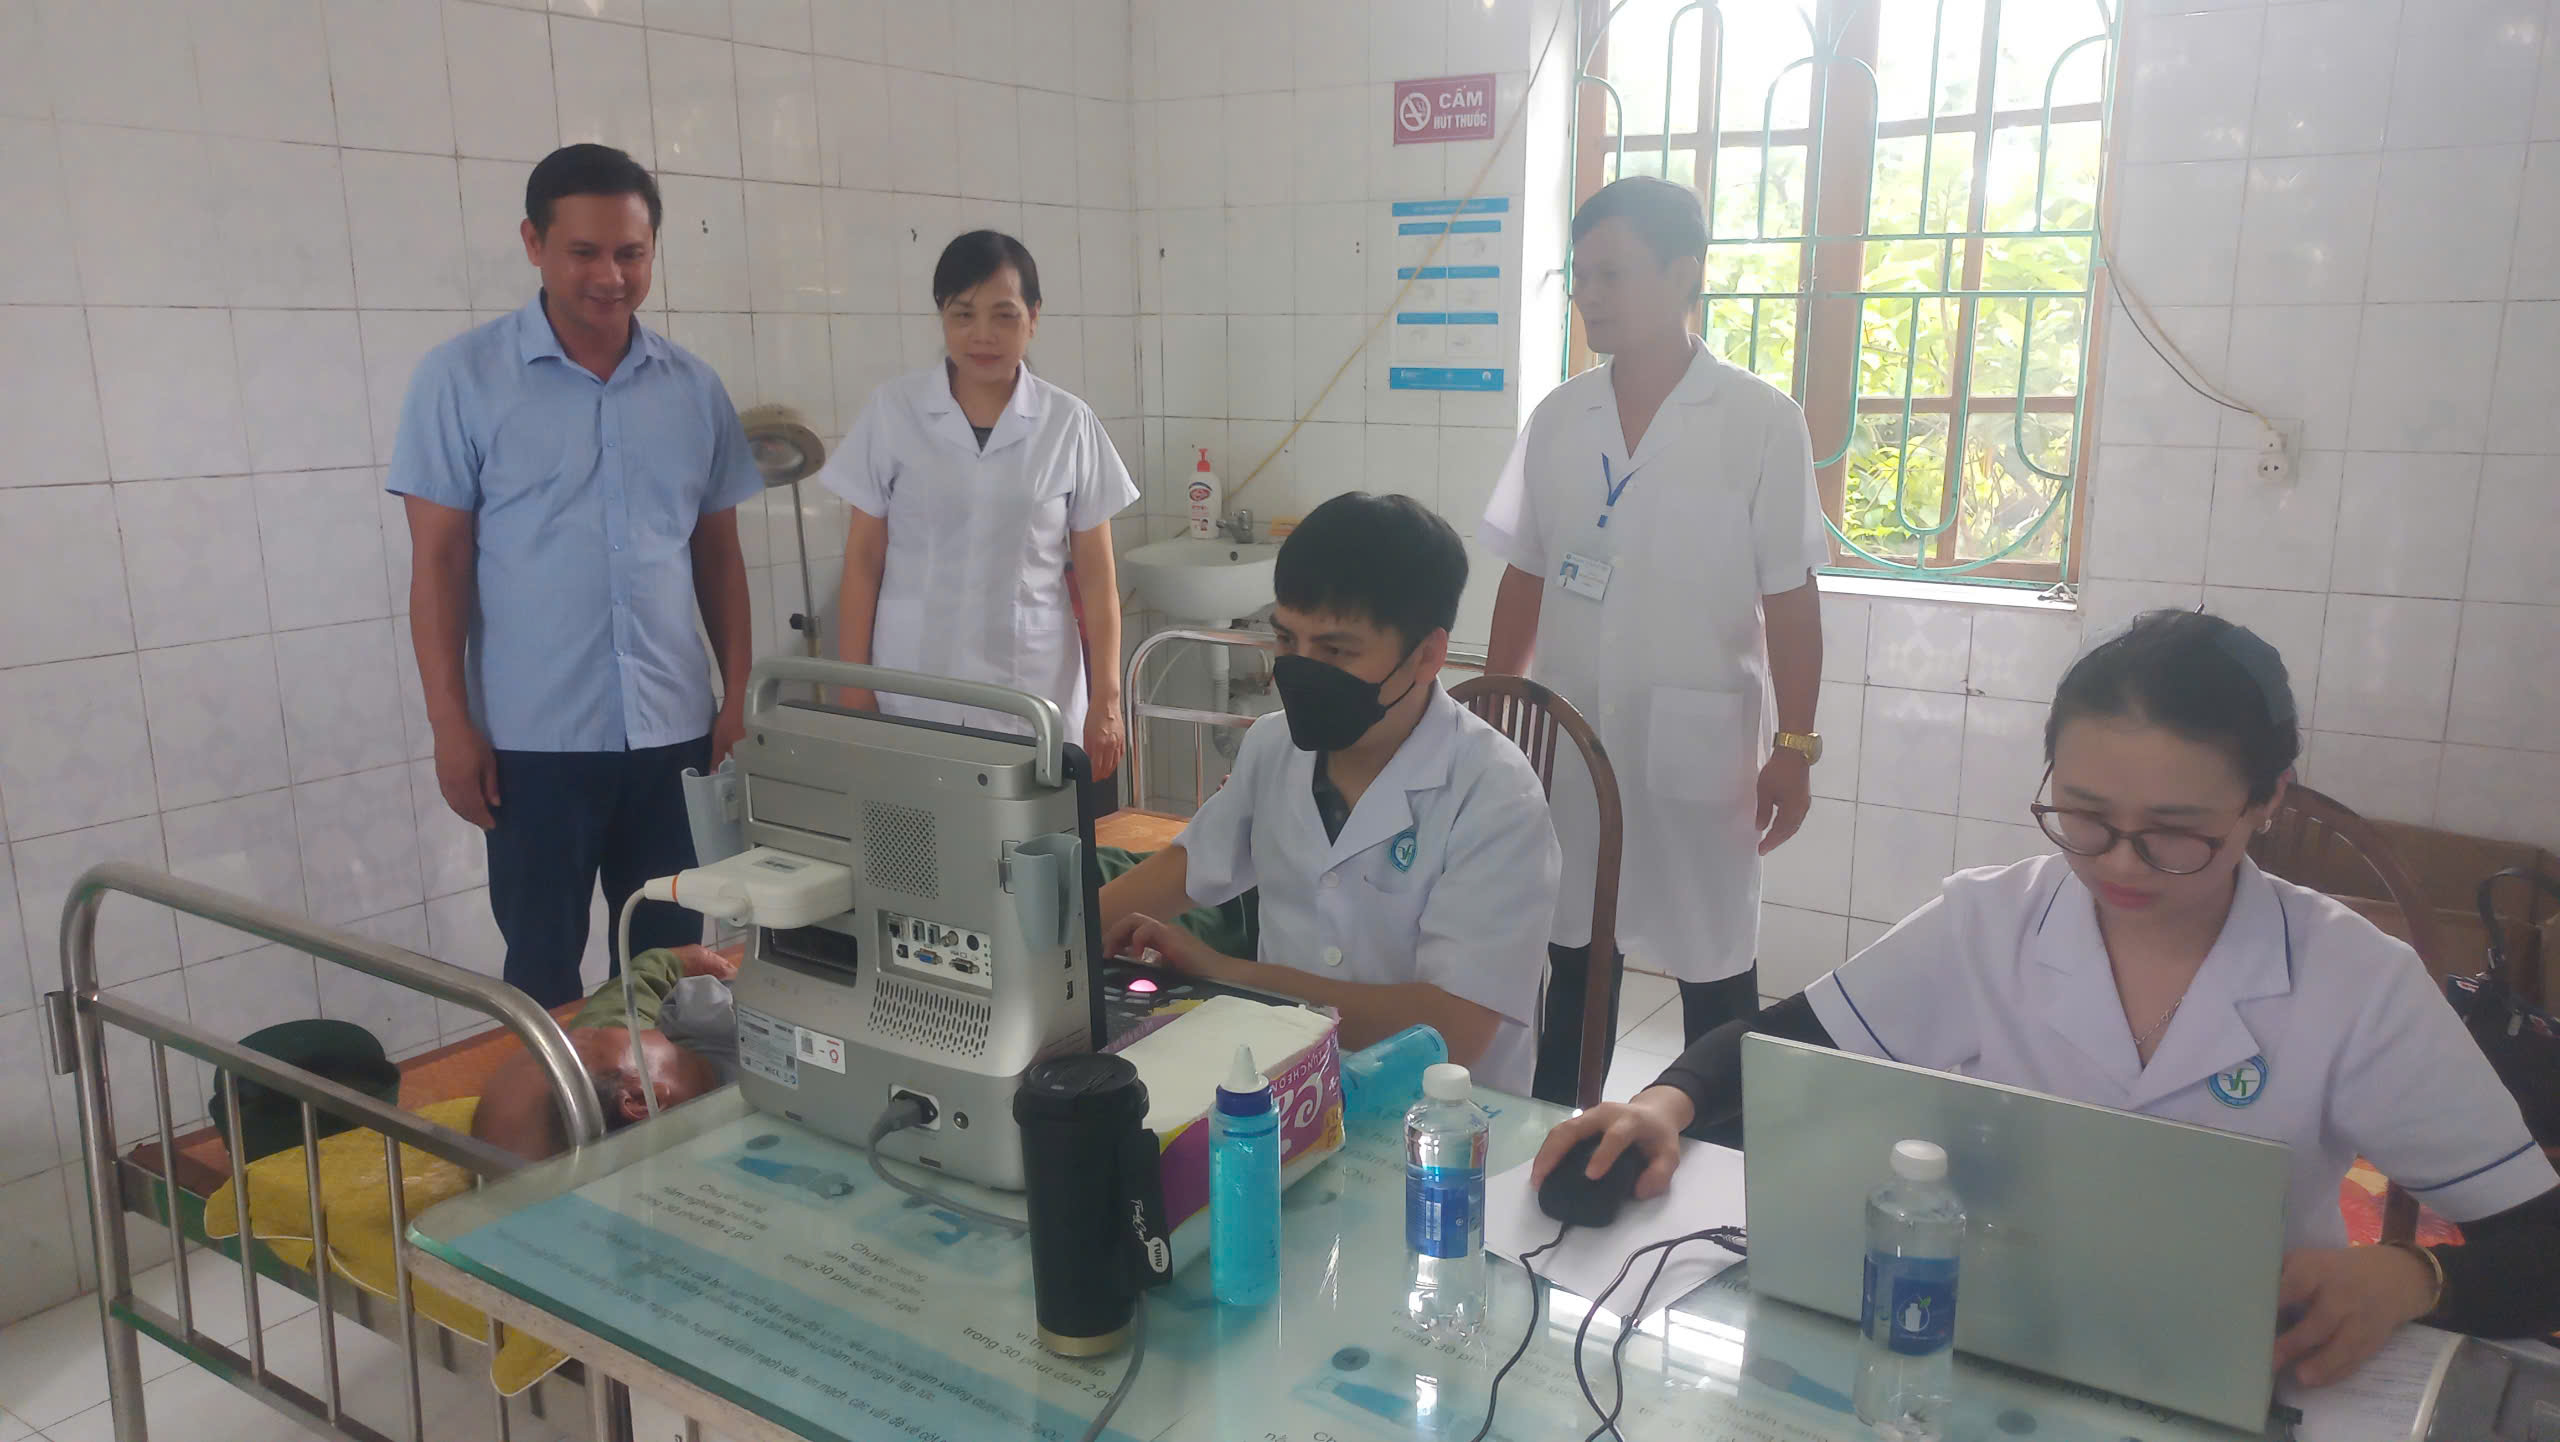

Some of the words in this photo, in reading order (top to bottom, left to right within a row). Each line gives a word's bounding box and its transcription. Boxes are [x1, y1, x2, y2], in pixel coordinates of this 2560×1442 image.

[1439, 85, 1483, 109] CẤM
[1455, 109, 1487, 129] THUỐC
[963, 1327, 999, 1349] trong
[1000, 1346, 1020, 1359] 30
[1082, 1384, 1096, 1392] 2
